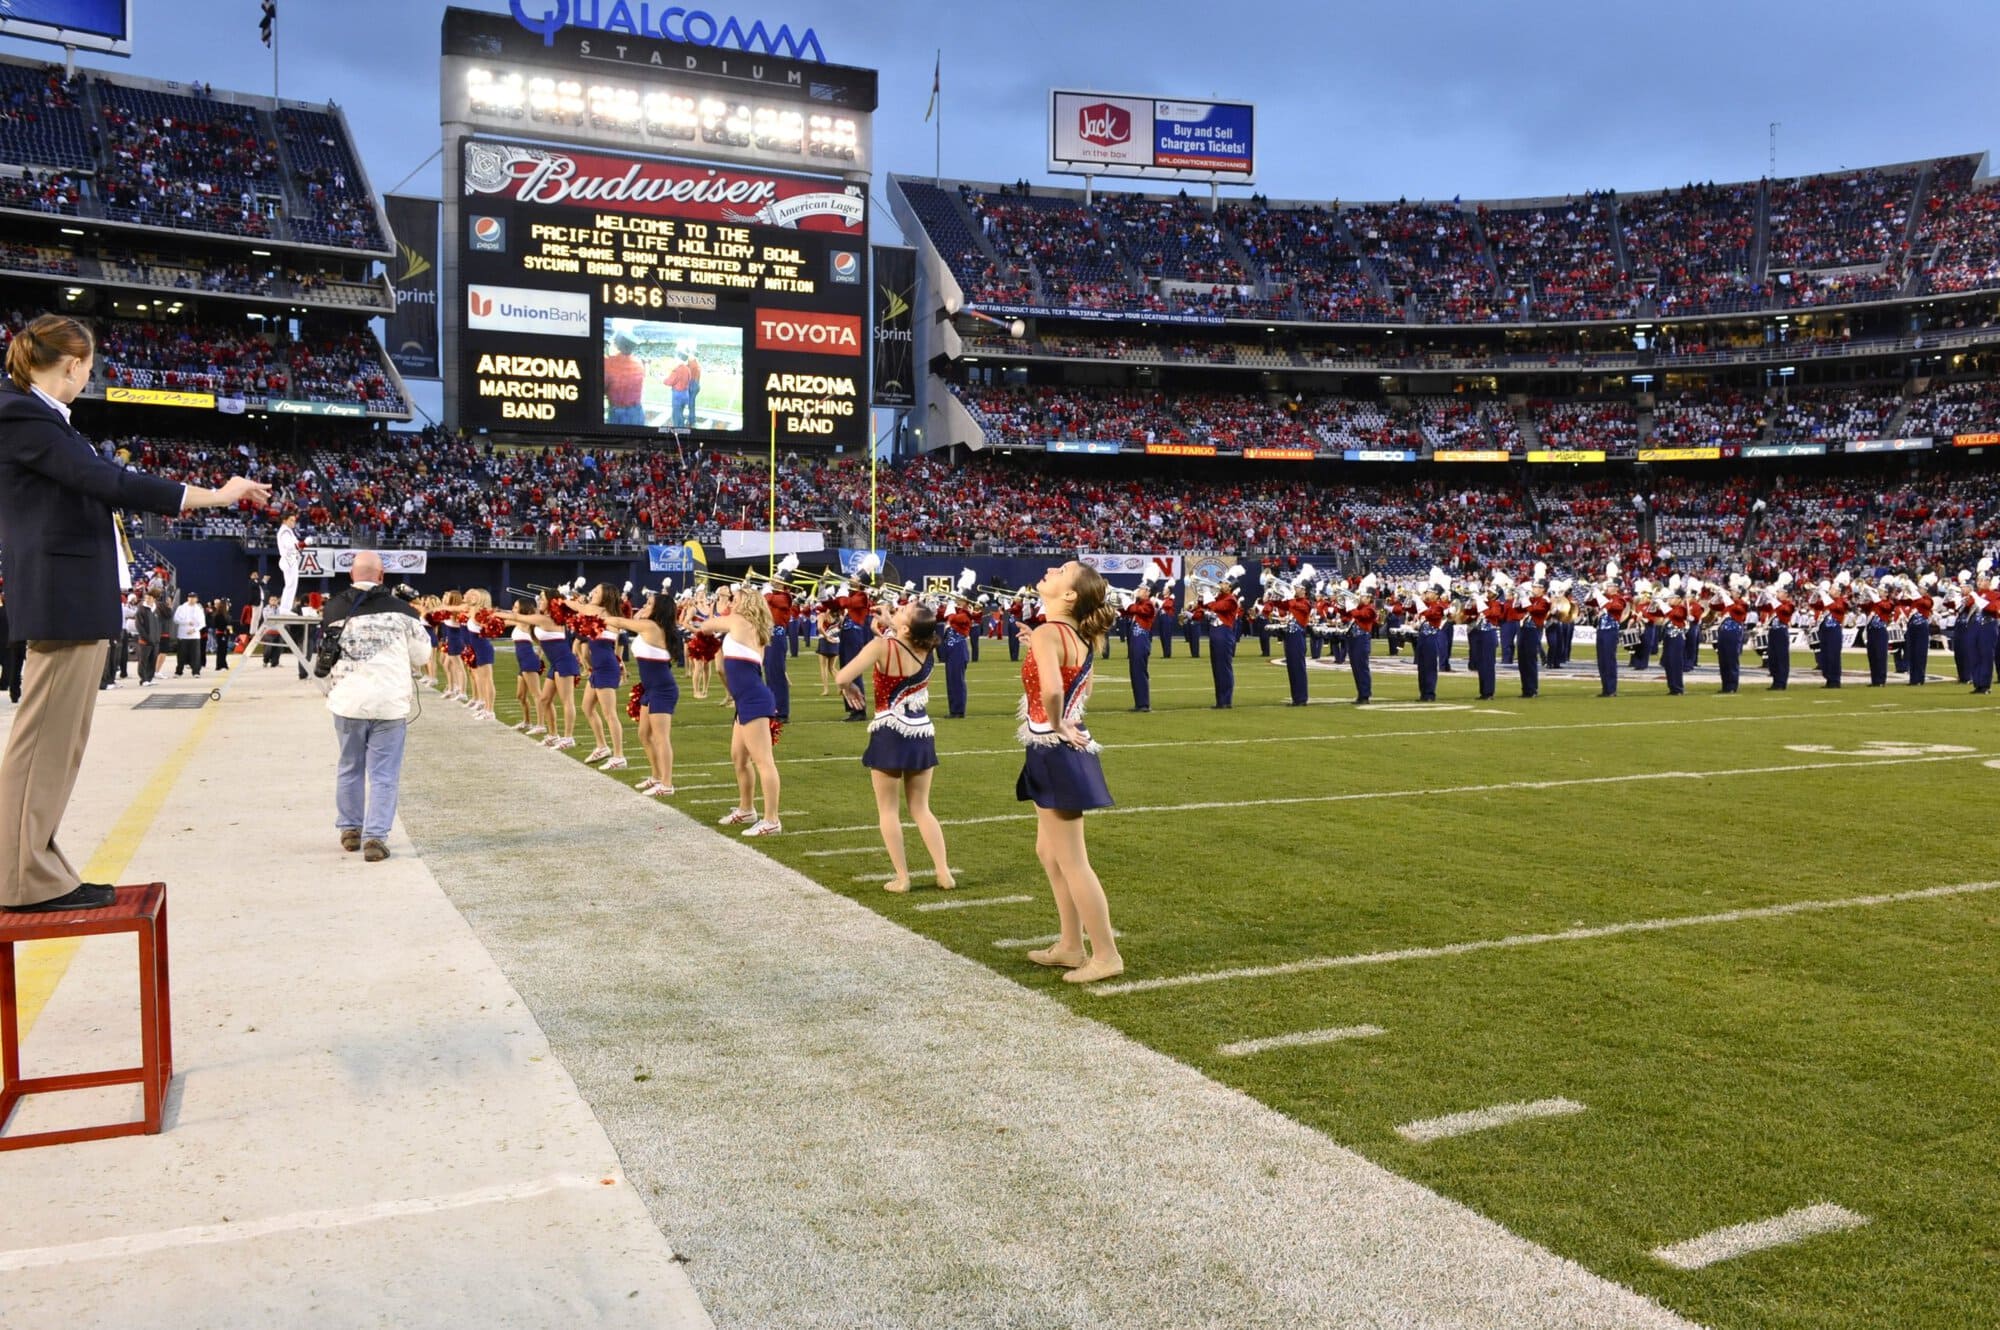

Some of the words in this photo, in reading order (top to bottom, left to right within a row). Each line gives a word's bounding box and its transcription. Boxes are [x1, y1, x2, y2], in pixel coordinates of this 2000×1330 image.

[509, 0, 826, 64] QUALCOMM
[580, 40, 802, 82] STADIUM
[1081, 108, 1128, 140] Jack
[1174, 123, 1192, 138] Buy
[1194, 126, 1212, 138] and
[1214, 127, 1233, 139] Sell
[1093, 149, 1109, 158] the
[1110, 150, 1127, 158] box
[1161, 137, 1205, 153] Chargers
[1207, 140, 1245, 154] Tickets!
[503, 157, 776, 205] Budweiser
[779, 200, 828, 219] American
[830, 200, 861, 214] Lager
[595, 214, 675, 236] WELCOME
[684, 223, 707, 239] TO
[716, 226, 750, 243] THE
[531, 224, 613, 246] PACIFIC
[622, 233, 669, 252] LIFE
[678, 238, 754, 259] HOLIDAY
[763, 247, 806, 265] BOWL
[542, 243, 614, 261] PRE-GAME
[622, 251, 658, 265] SHOW
[664, 254, 741, 272] PRESENTED
[748, 262, 766, 276] BY
[773, 265, 798, 278] THE
[523, 255, 580, 273] SYCUAN
[587, 261, 623, 277] BAND
[630, 266, 649, 279] OF
[657, 268, 683, 282] THE
[690, 270, 758, 289] KUMEYAAY
[764, 278, 815, 294] NATION
[603, 283, 663, 308] 19:56
[668, 294, 715, 305] SYCUAN
[500, 303, 587, 322] UnionBank
[761, 321, 857, 346] TOYOTA
[874, 326, 912, 343] Sprint
[477, 354, 582, 380] ARIZONA
[479, 379, 579, 401] MARCHING
[765, 373, 856, 397] ARIZONA
[502, 401, 556, 420] BAND
[767, 396, 854, 416] MARCHING
[787, 417, 834, 434] BAND
[1956, 434, 1998, 445] WELLS
[1147, 445, 1181, 454] WELLS
[1183, 446, 1215, 456] FARGO
[298, 550, 324, 575] A
[651, 562, 681, 571] PACIFIC
[1152, 557, 1174, 577] N
[928, 577, 949, 593] 25
